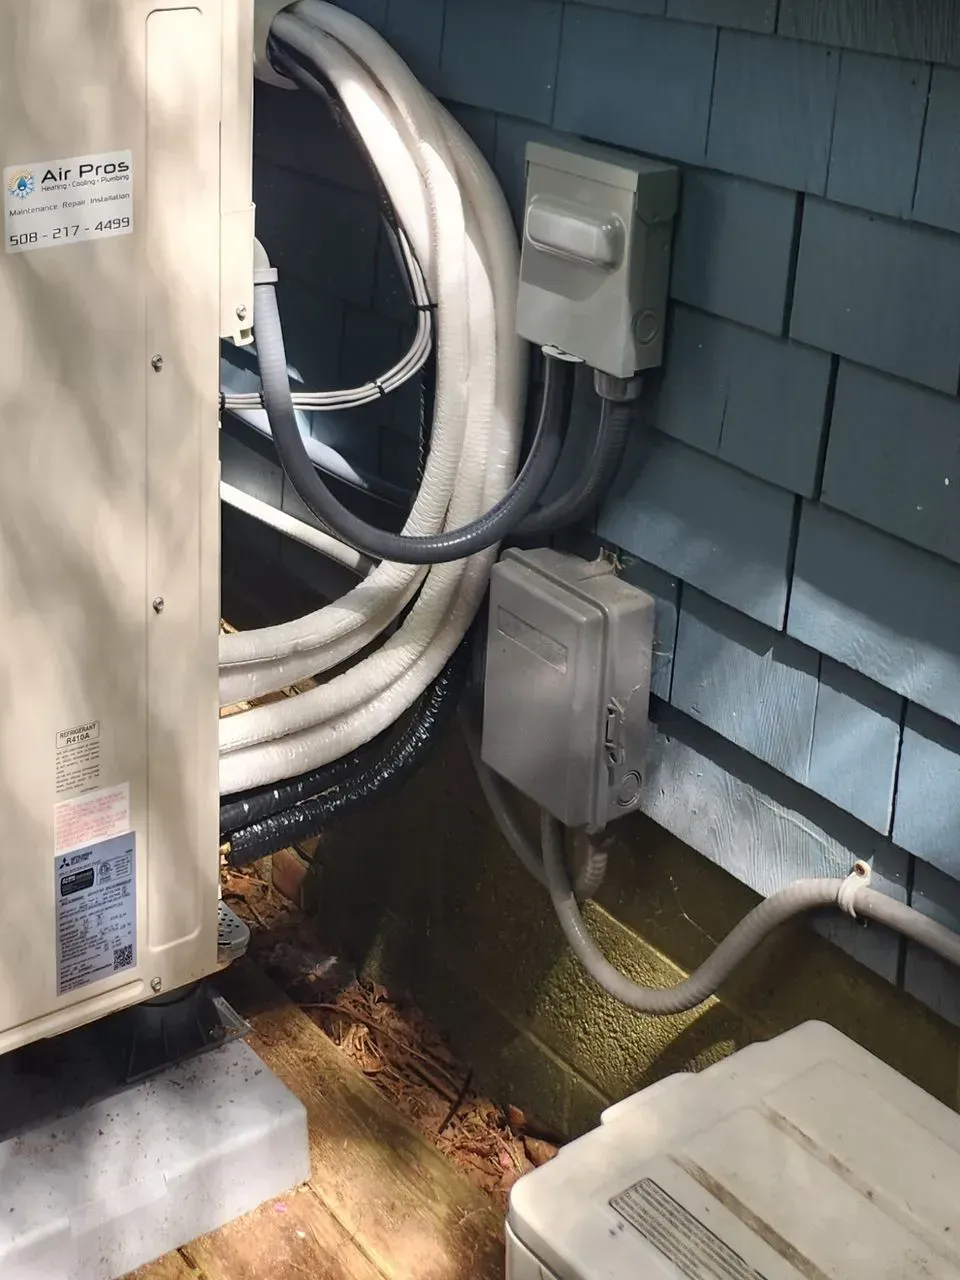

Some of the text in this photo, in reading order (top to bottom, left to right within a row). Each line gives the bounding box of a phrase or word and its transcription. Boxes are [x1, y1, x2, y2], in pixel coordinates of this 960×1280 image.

[41, 162, 129, 184] Air Pros
[41, 174, 129, 192] Heating Cooling Plumbing
[9, 192, 130, 217] Maintenance Repair Installation
[10, 232, 38, 246] 508
[52, 225, 80, 239] 217
[94, 217, 130, 232] 4499
[60, 723, 96, 739] REFRIGERANT
[66, 732, 90, 745] R410A
